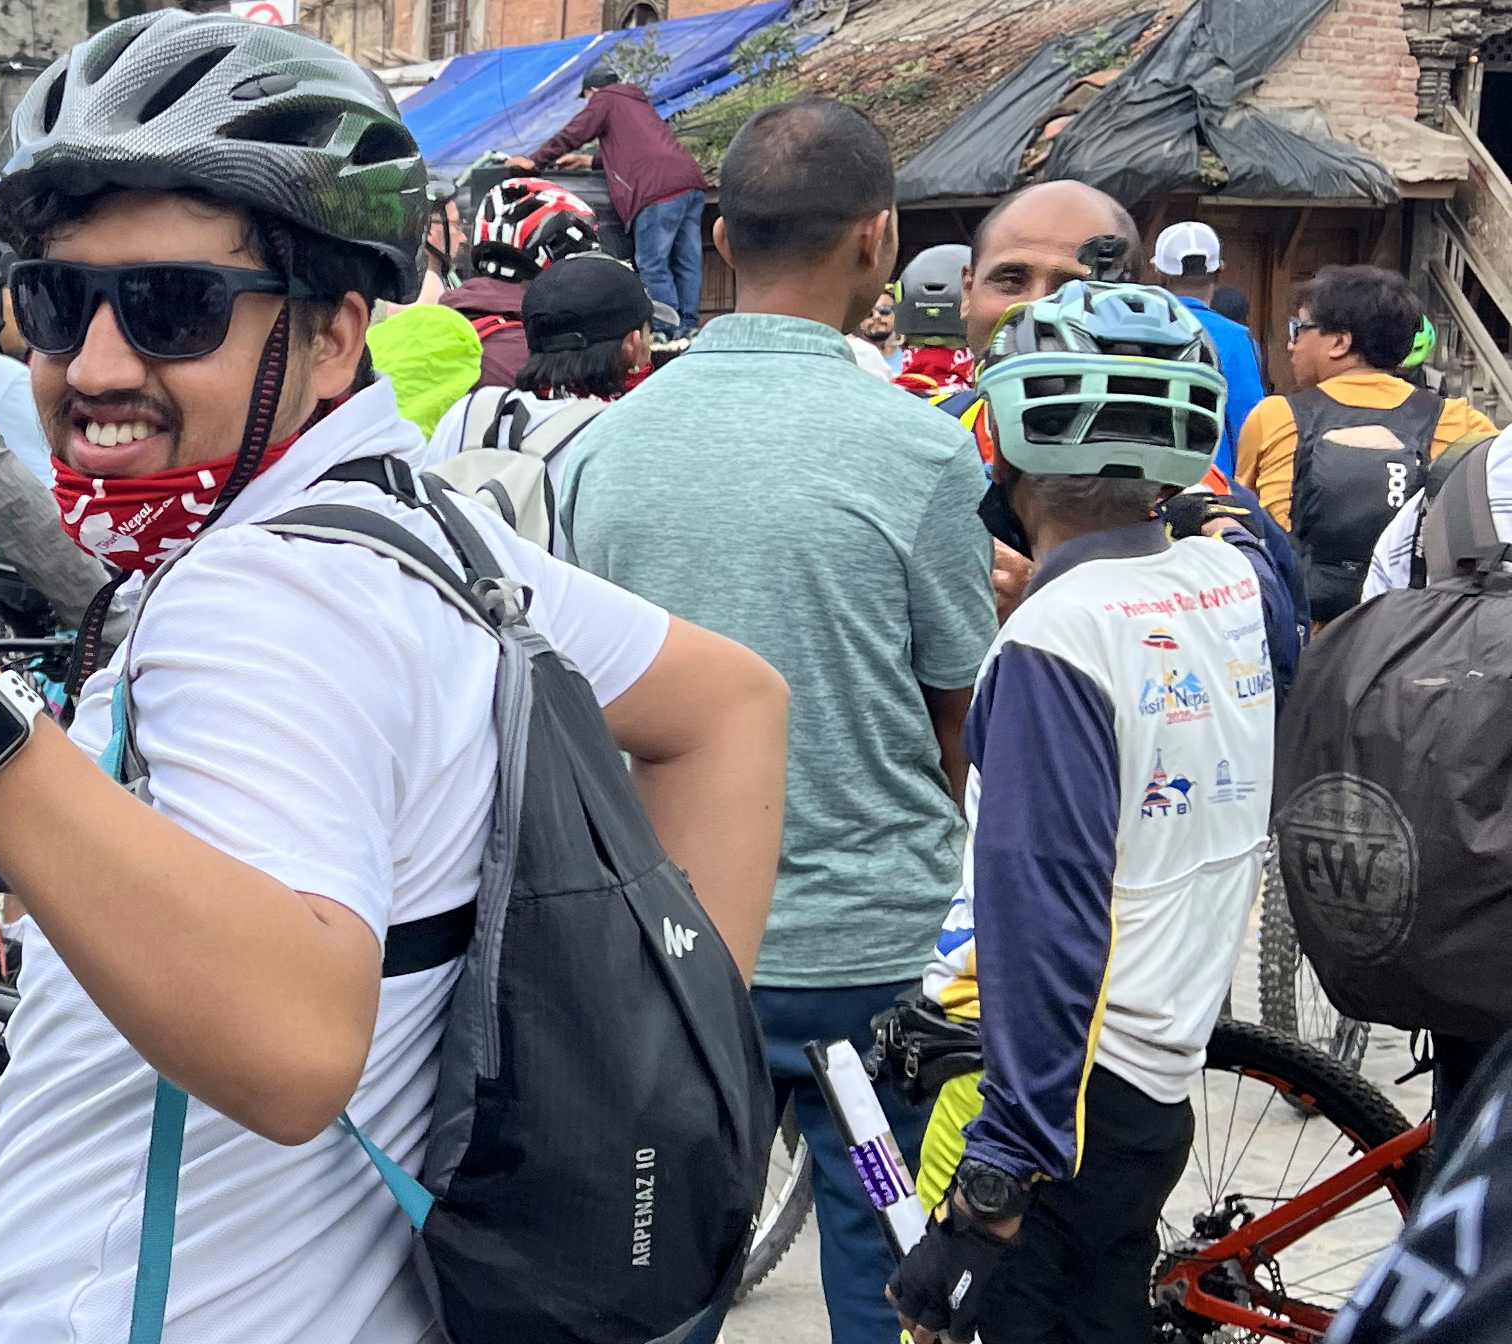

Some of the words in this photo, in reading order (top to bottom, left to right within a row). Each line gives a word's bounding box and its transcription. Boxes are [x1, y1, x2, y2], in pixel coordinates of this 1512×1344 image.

[117, 503, 154, 535] Nepal
[635, 1147, 656, 1170] 10
[631, 1174, 655, 1266] ARPENAZ
